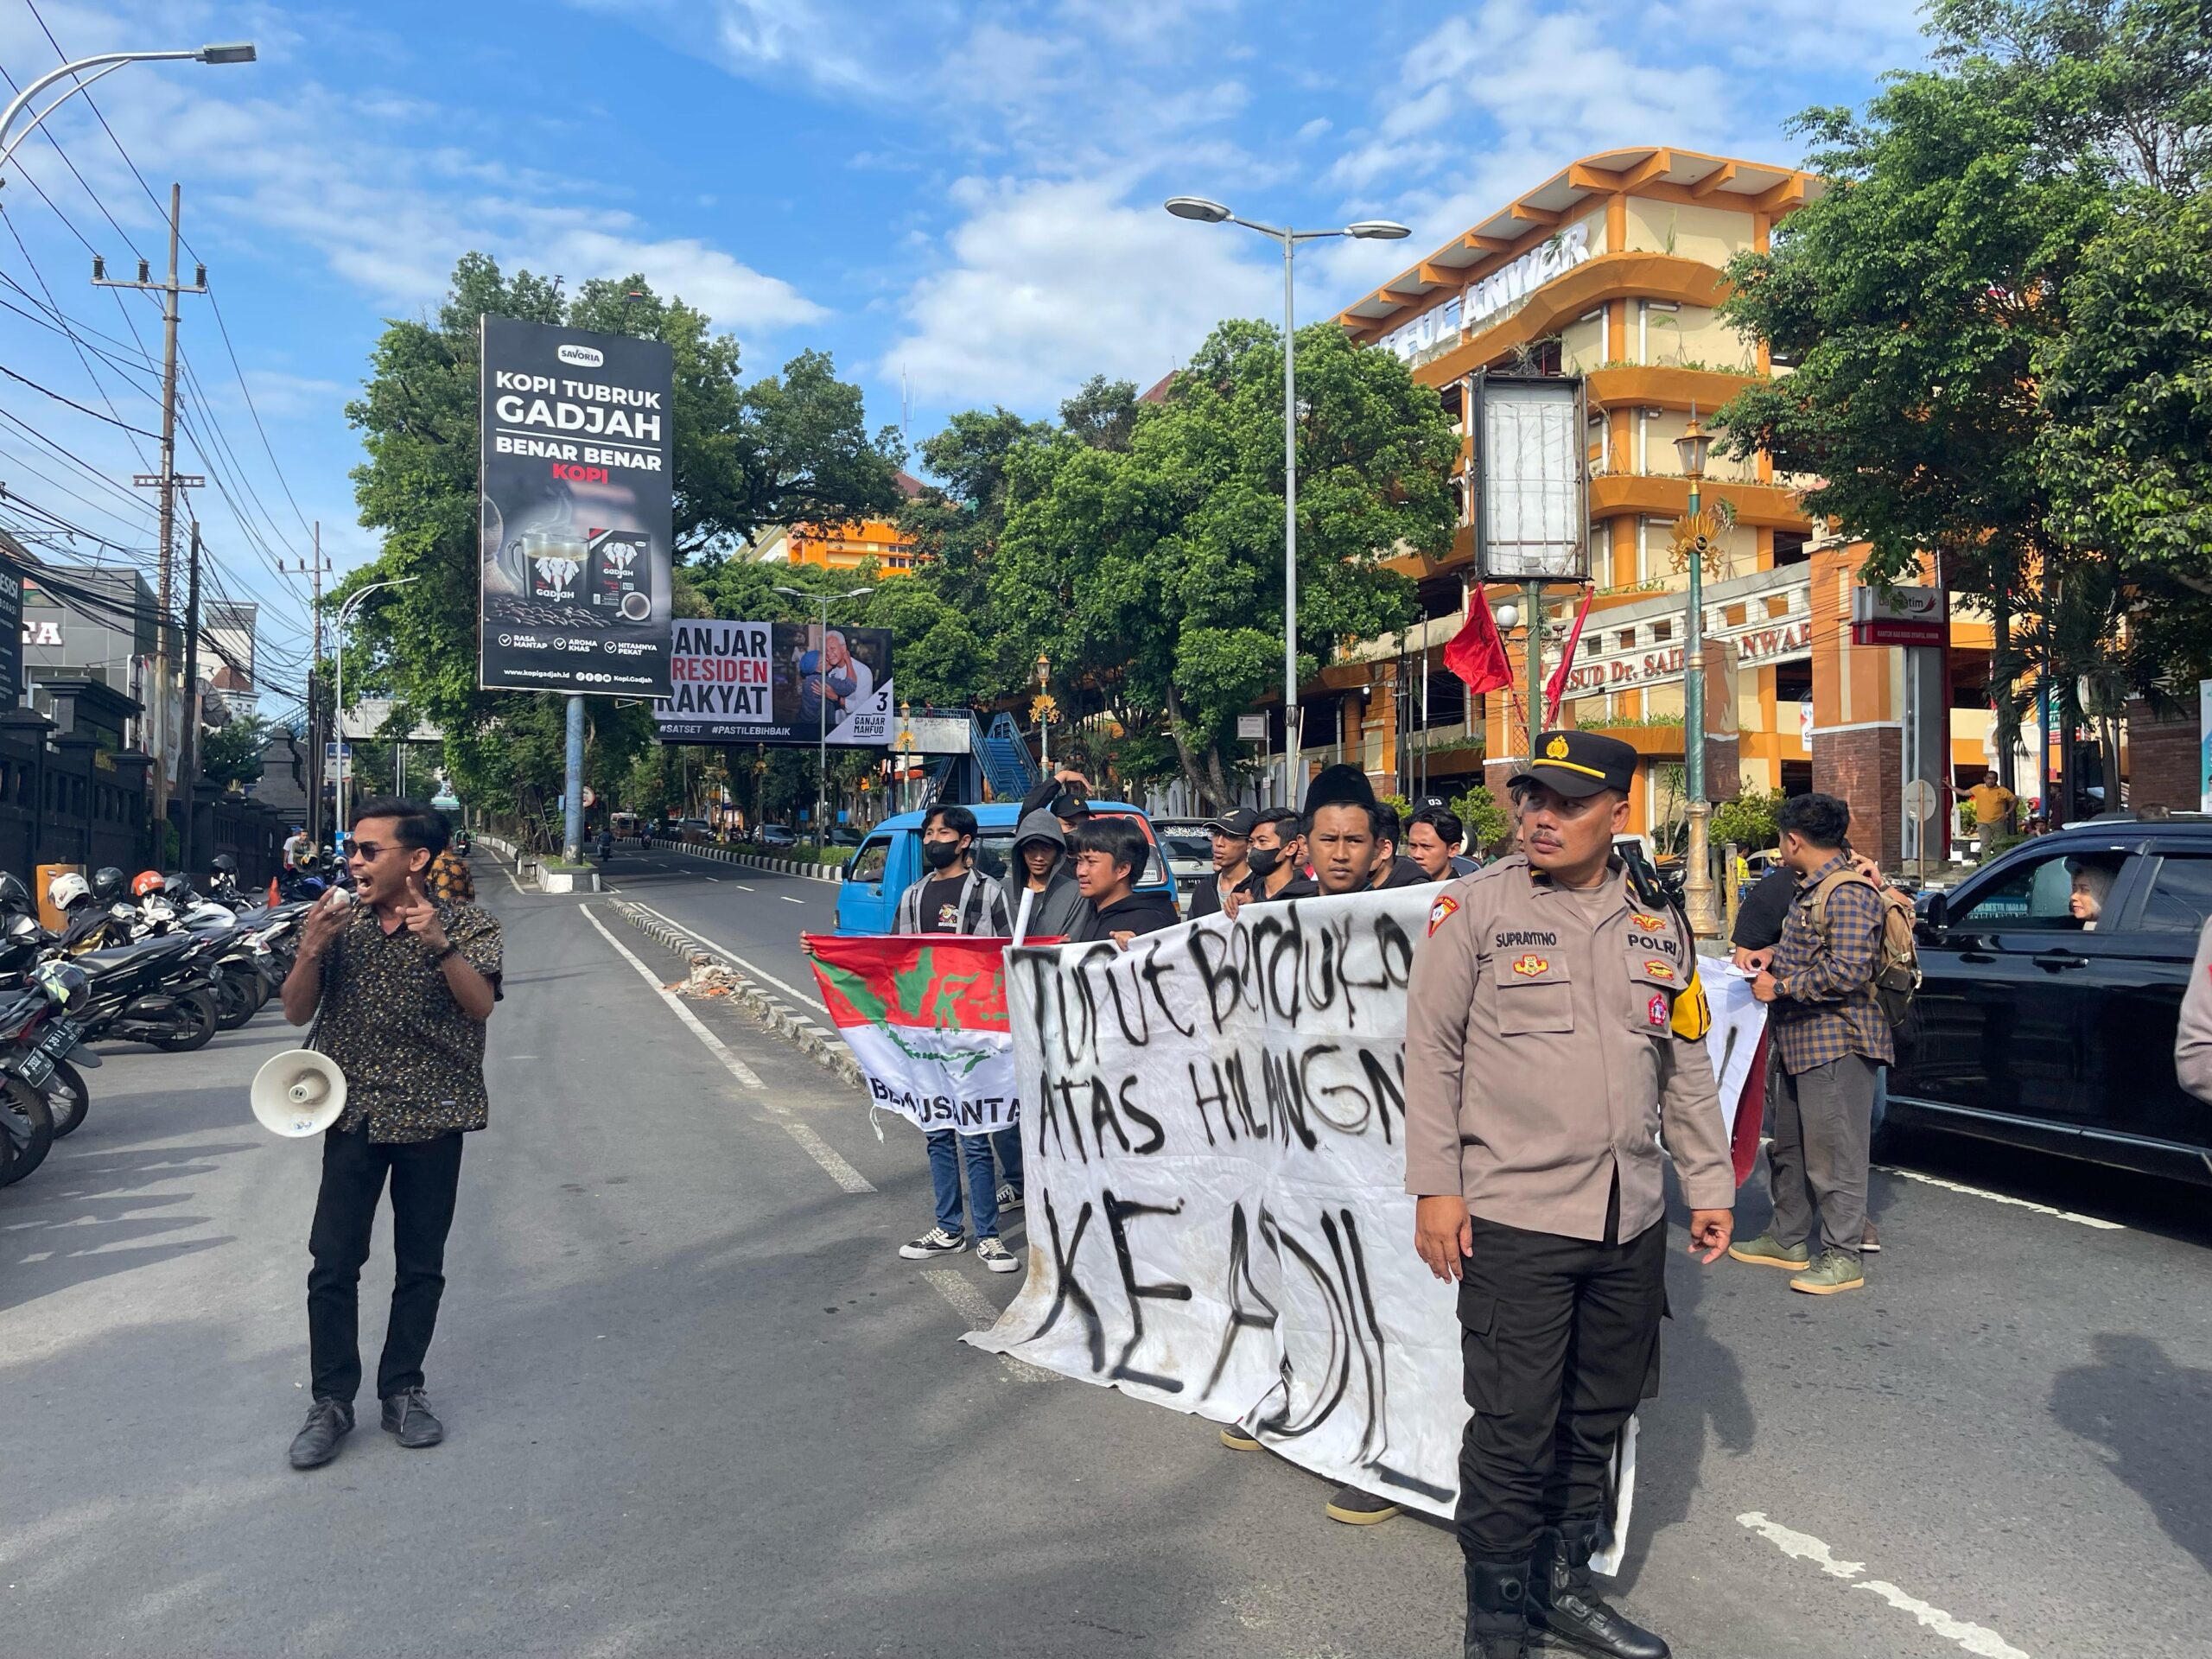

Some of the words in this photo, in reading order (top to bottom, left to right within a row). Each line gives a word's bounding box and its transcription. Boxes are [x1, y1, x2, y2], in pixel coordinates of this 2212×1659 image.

[1380, 301, 1457, 362] FUL
[1460, 223, 1591, 329] ANWAR
[562, 349, 600, 363] SAVORIA
[496, 370, 556, 395] KOPI
[563, 380, 662, 410] TUBRUK
[495, 395, 661, 442] GADJAH
[496, 436, 578, 461] BENAR
[584, 447, 662, 472] BENAR
[552, 463, 608, 485] KOPI
[0, 573, 18, 600] ESISI
[0, 597, 17, 616] ORASI
[513, 634, 536, 643] RASA
[569, 639, 598, 647] AROMA
[618, 642, 658, 652] HITAMNYA
[513, 640, 548, 649] MANTAP
[671, 626, 767, 658] ANJAR
[1564, 664, 1605, 690] SUD
[1611, 660, 1639, 682] Dr.
[1732, 623, 1811, 660] NWAR
[504, 669, 570, 679] www.kopigadjah.id
[613, 675, 653, 684] Kopi.Gadjah
[672, 657, 768, 683] RESIDEN
[658, 683, 768, 715] RAKYAT
[876, 692, 888, 711] 3
[659, 724, 702, 734] #SATSET
[712, 726, 791, 735] #PASTILEBIHBAIK
[854, 725, 884, 734] MAHFUD
[855, 716, 885, 725] GANJAR
[1496, 931, 1557, 948] SUPRAYITNO
[1628, 934, 1676, 956] POLRI
[1039, 1070, 1165, 1165] ATAS
[1016, 1187, 1456, 1503] KEADIL
